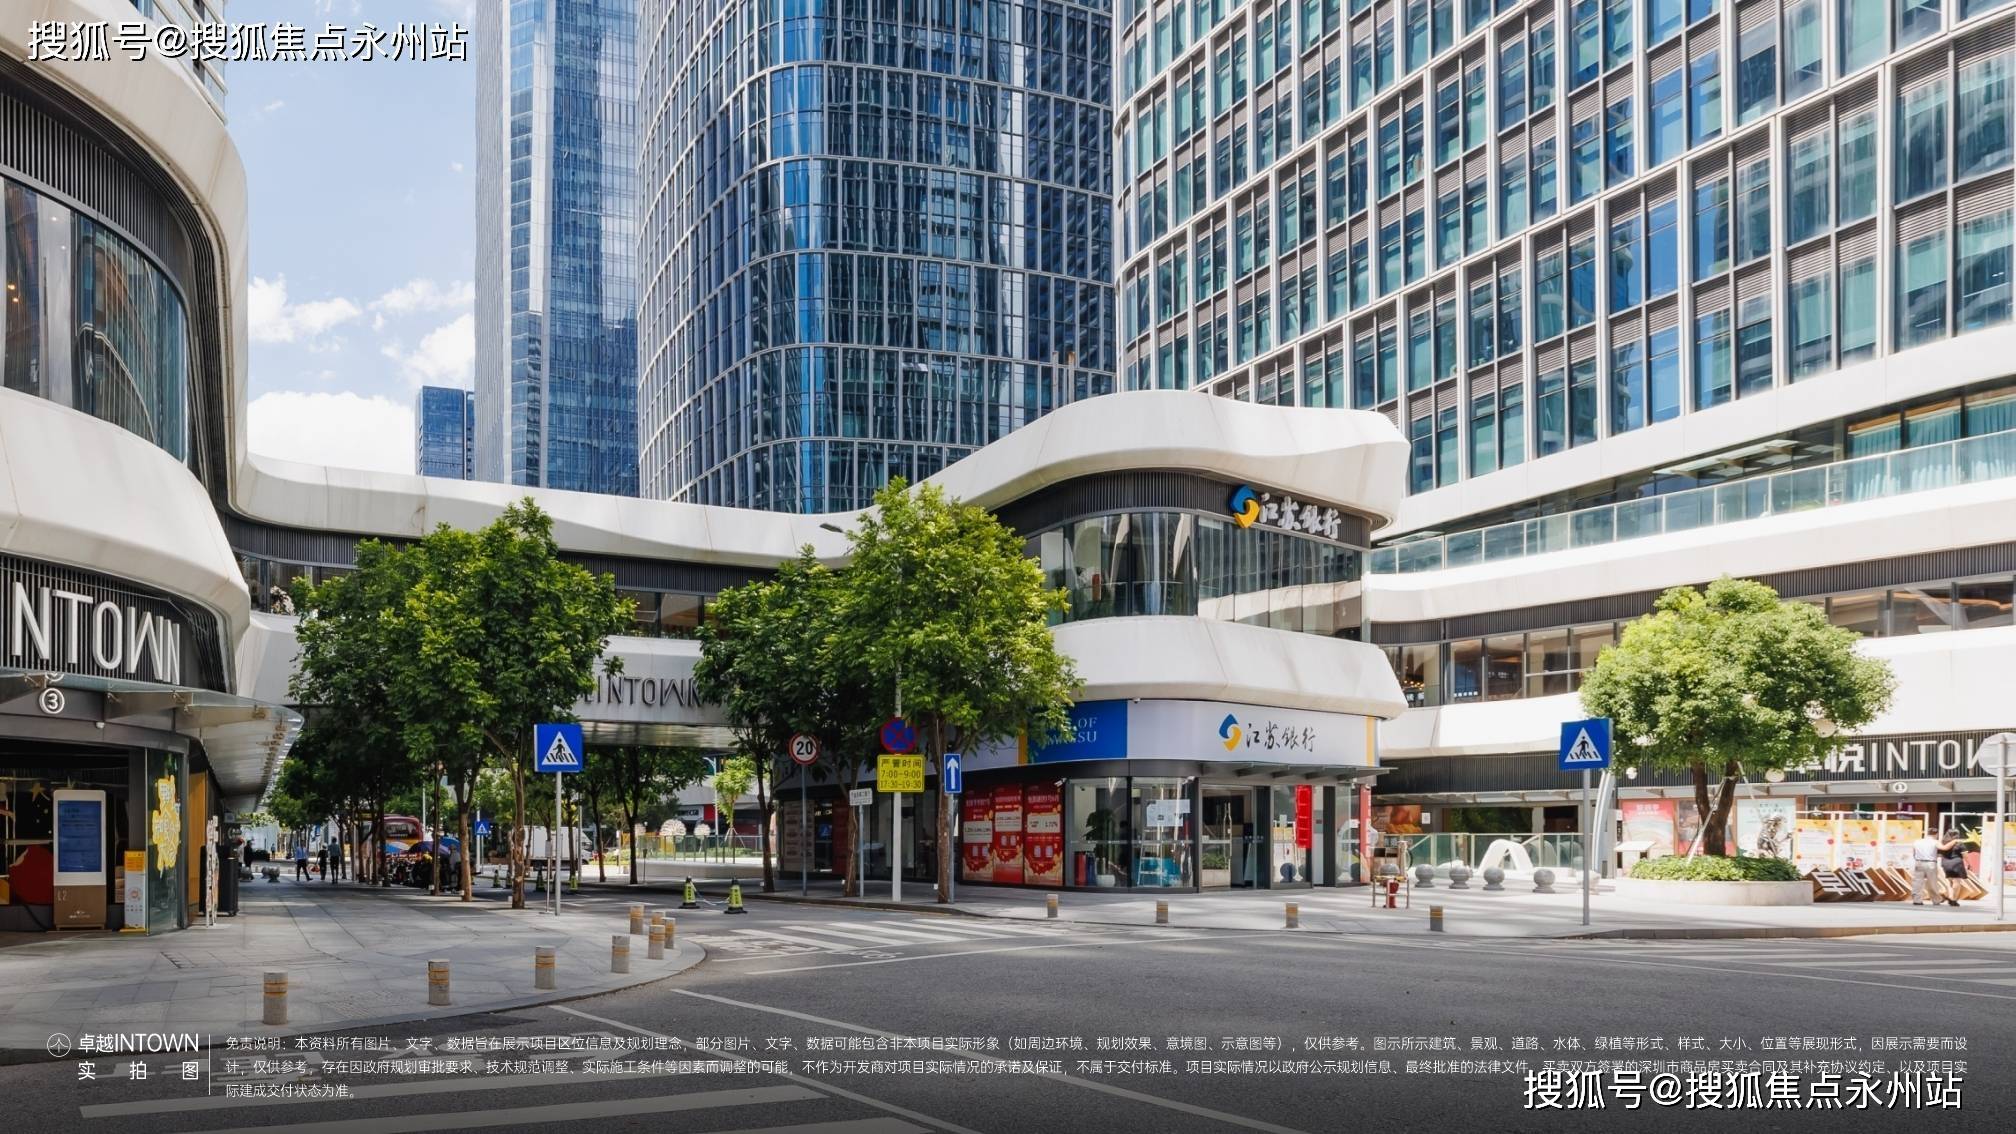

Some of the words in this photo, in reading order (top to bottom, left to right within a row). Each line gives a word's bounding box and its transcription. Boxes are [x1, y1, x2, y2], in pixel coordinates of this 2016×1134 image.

[1259, 492, 1341, 539] 江苏银行
[1078, 717, 1098, 728] OF
[1246, 721, 1316, 752] 江苏银行
[796, 741, 814, 755] 20
